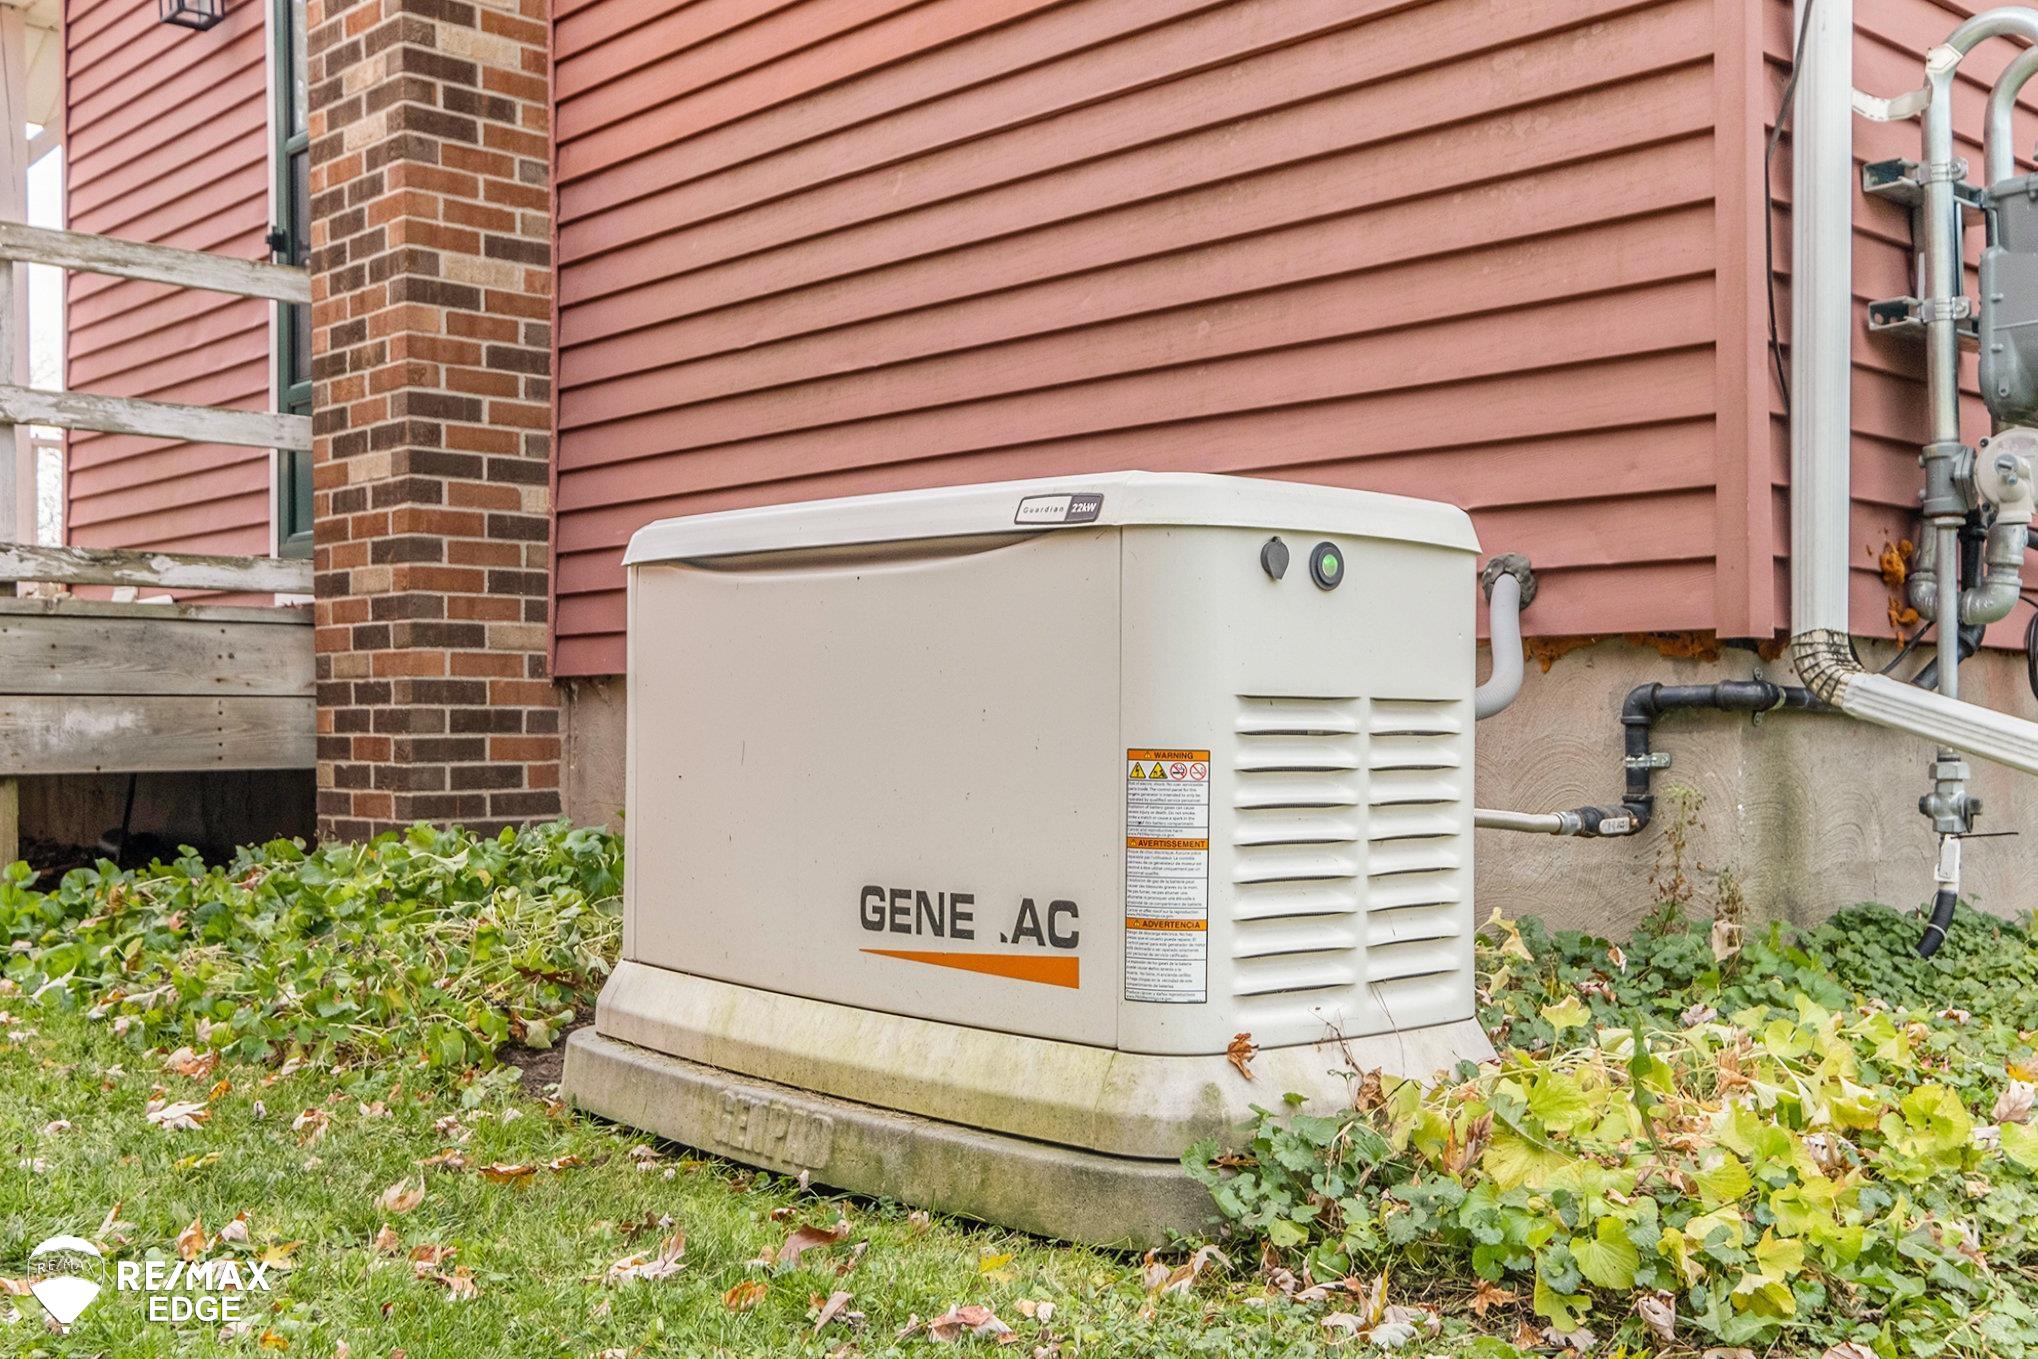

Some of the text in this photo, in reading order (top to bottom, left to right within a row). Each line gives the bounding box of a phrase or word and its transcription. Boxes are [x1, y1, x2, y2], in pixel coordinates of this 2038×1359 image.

[1023, 502, 1097, 514] Guardian 22kW
[1153, 751, 1194, 760] WARNING
[1138, 839, 1205, 848] AVERTISSEMENT
[860, 885, 1080, 949] GENEAC
[1142, 920, 1201, 929] ADVERTENCIA
